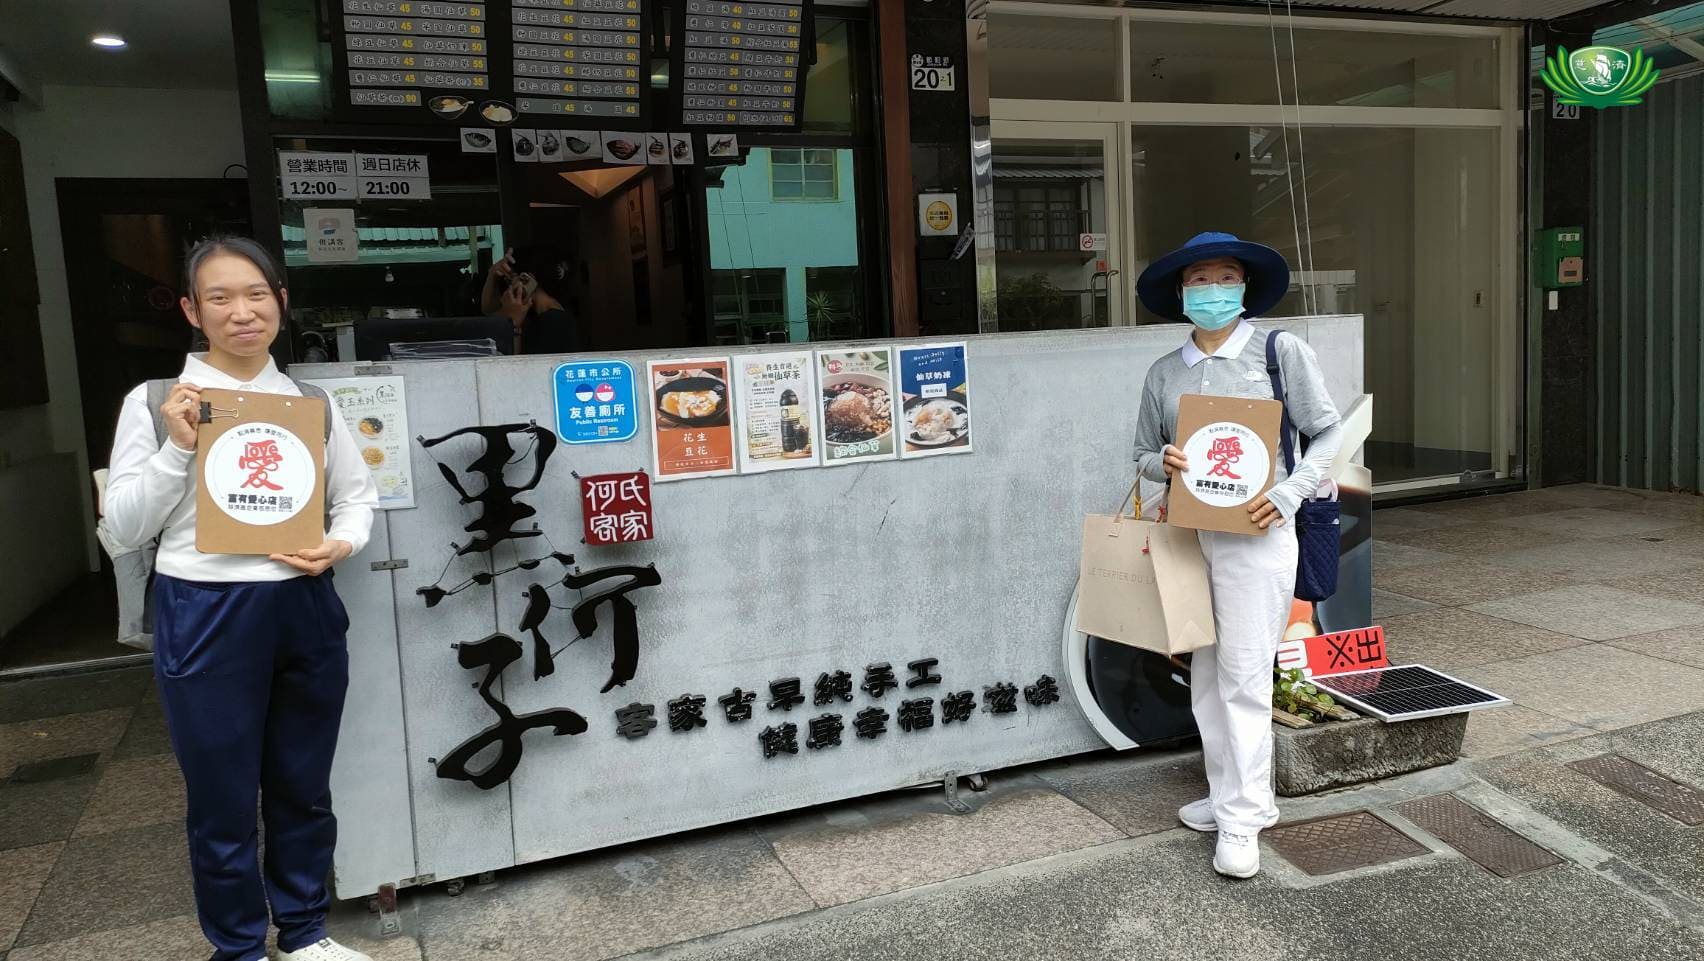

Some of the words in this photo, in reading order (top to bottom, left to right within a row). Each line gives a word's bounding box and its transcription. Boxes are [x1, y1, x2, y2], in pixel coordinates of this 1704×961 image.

[1556, 103, 1577, 118] 20
[287, 159, 348, 174] 營業時間
[362, 157, 422, 173] 週日店休
[366, 181, 410, 195] 21:00
[565, 367, 622, 379] 花蓮市公所
[569, 404, 625, 419] 友善廁所
[683, 432, 707, 443] 花生
[685, 446, 708, 457] 豆花
[585, 475, 647, 511] 何氏
[1196, 479, 1236, 492] 富有愛心店
[227, 493, 278, 506] 富有愛心店
[590, 509, 649, 542] 客家
[615, 657, 942, 740] 客家古早純手工
[758, 674, 1060, 759] 健康幸福好滋味
